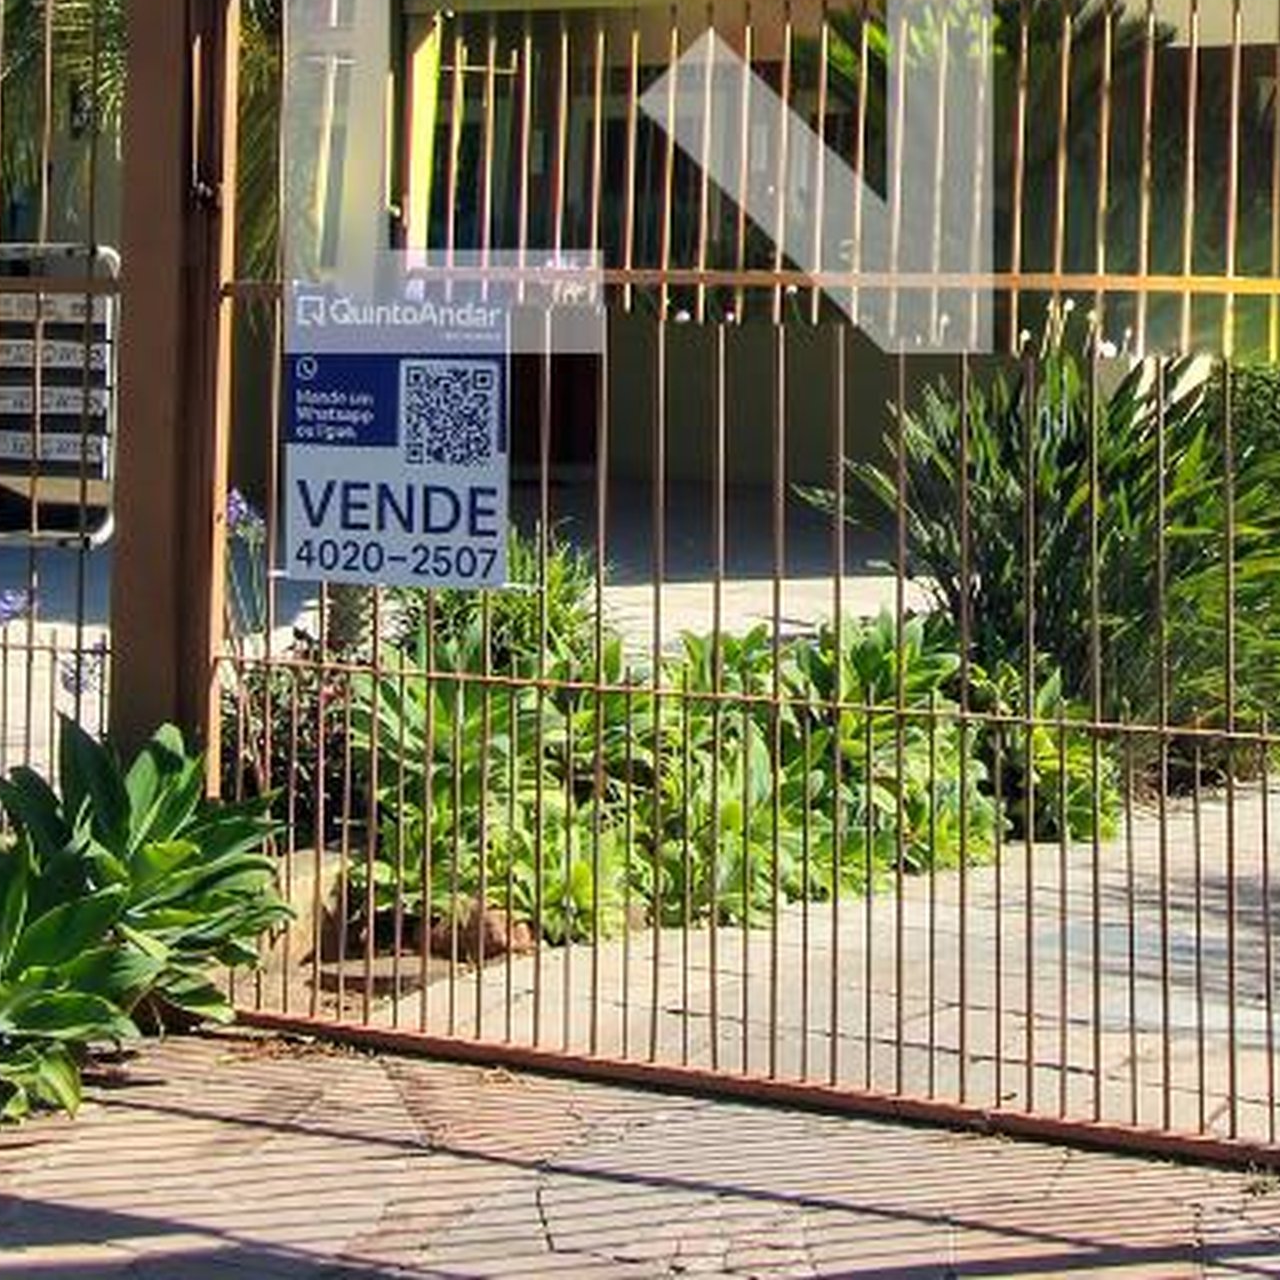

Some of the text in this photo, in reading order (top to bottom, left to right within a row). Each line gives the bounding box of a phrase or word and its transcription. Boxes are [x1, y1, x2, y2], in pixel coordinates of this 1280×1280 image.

[329, 297, 501, 327] QuintoAndar
[296, 480, 498, 537] VENDE
[295, 539, 498, 580] 4020-2507
